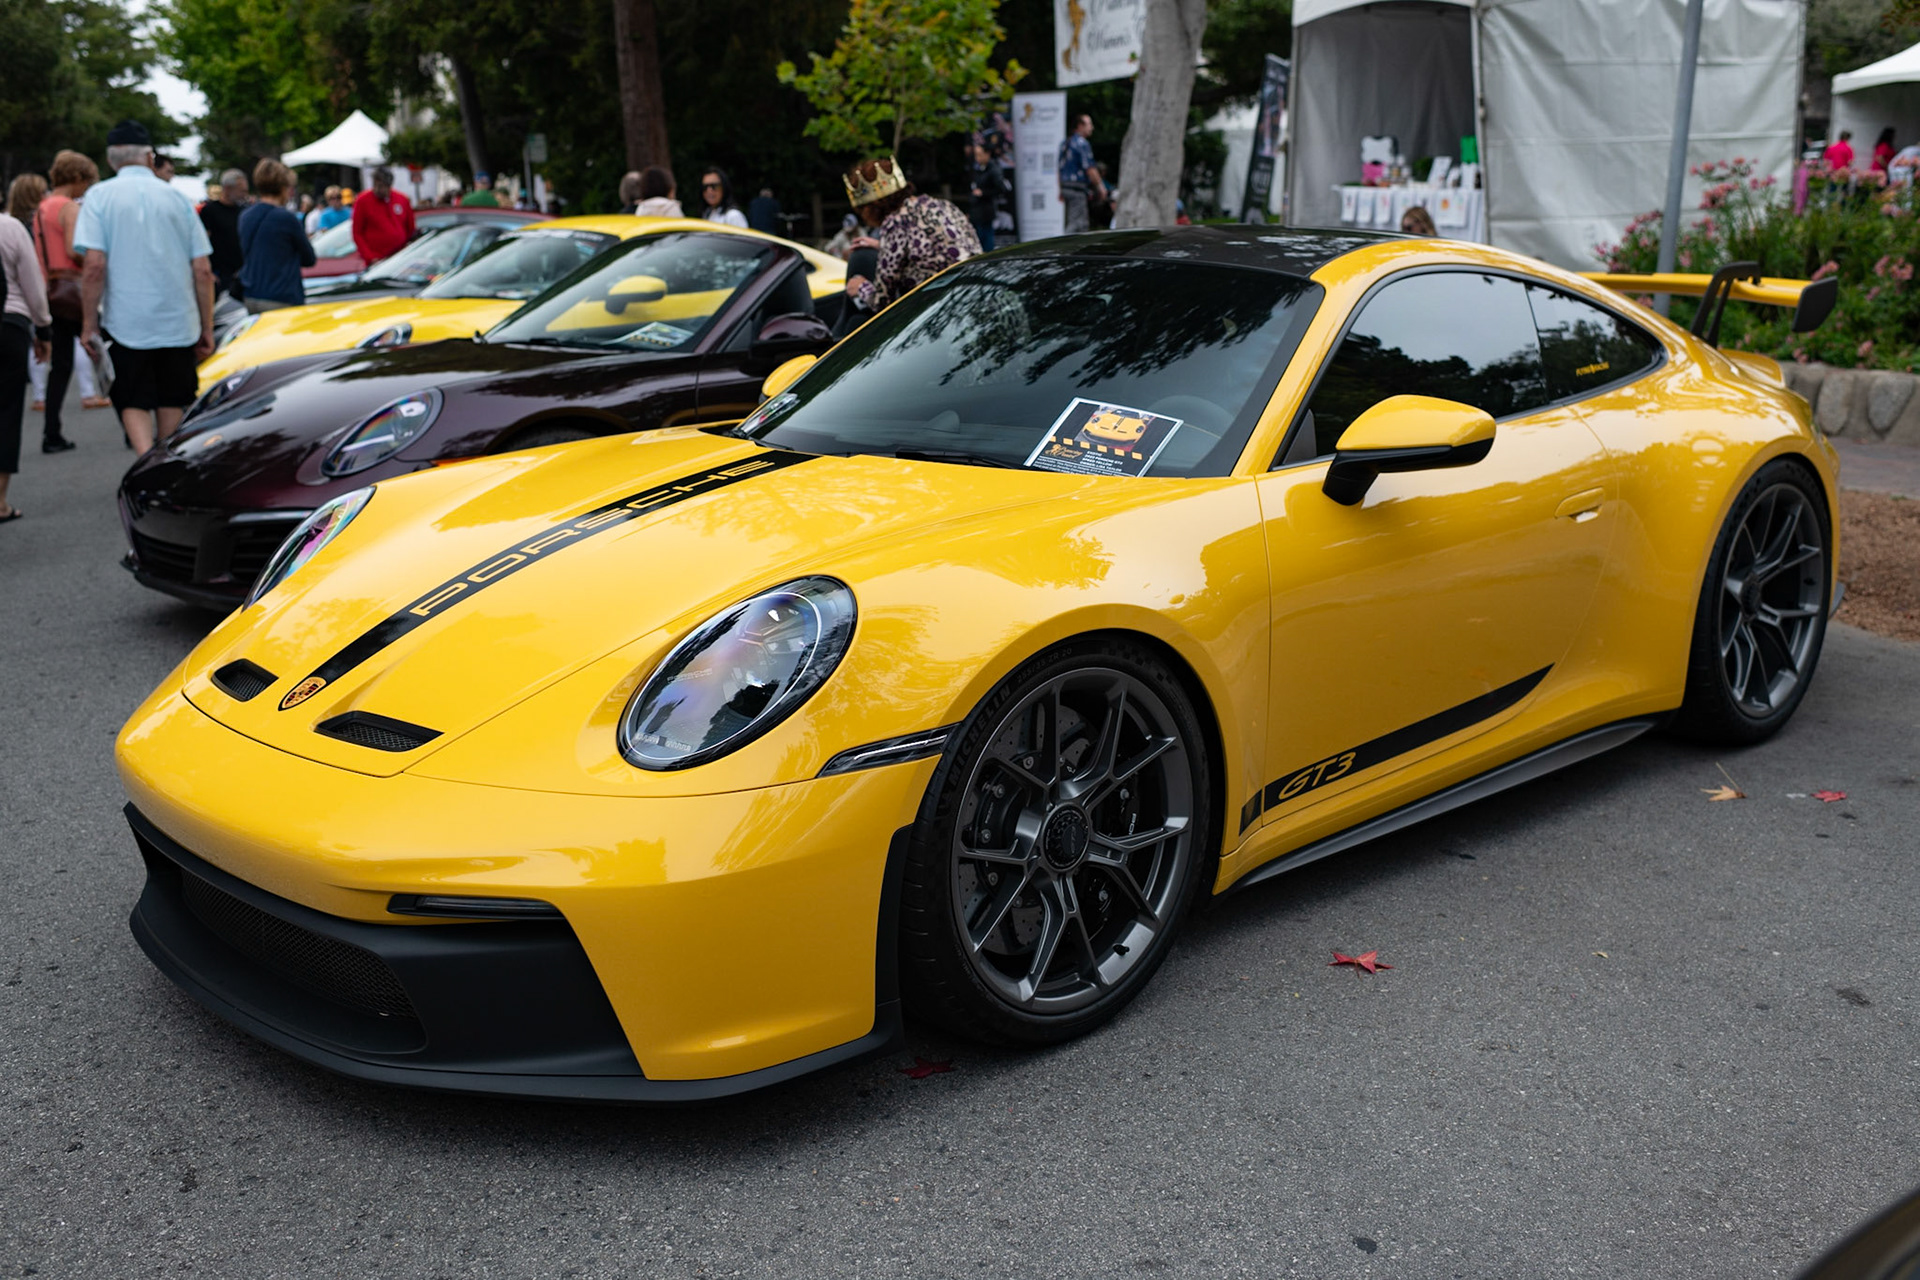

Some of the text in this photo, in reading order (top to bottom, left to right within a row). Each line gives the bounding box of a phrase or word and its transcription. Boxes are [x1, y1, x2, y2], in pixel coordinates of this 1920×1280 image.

[409, 459, 776, 617] PORSCHE
[947, 683, 1013, 787] MICHELIN
[1278, 751, 1357, 800] GT3
